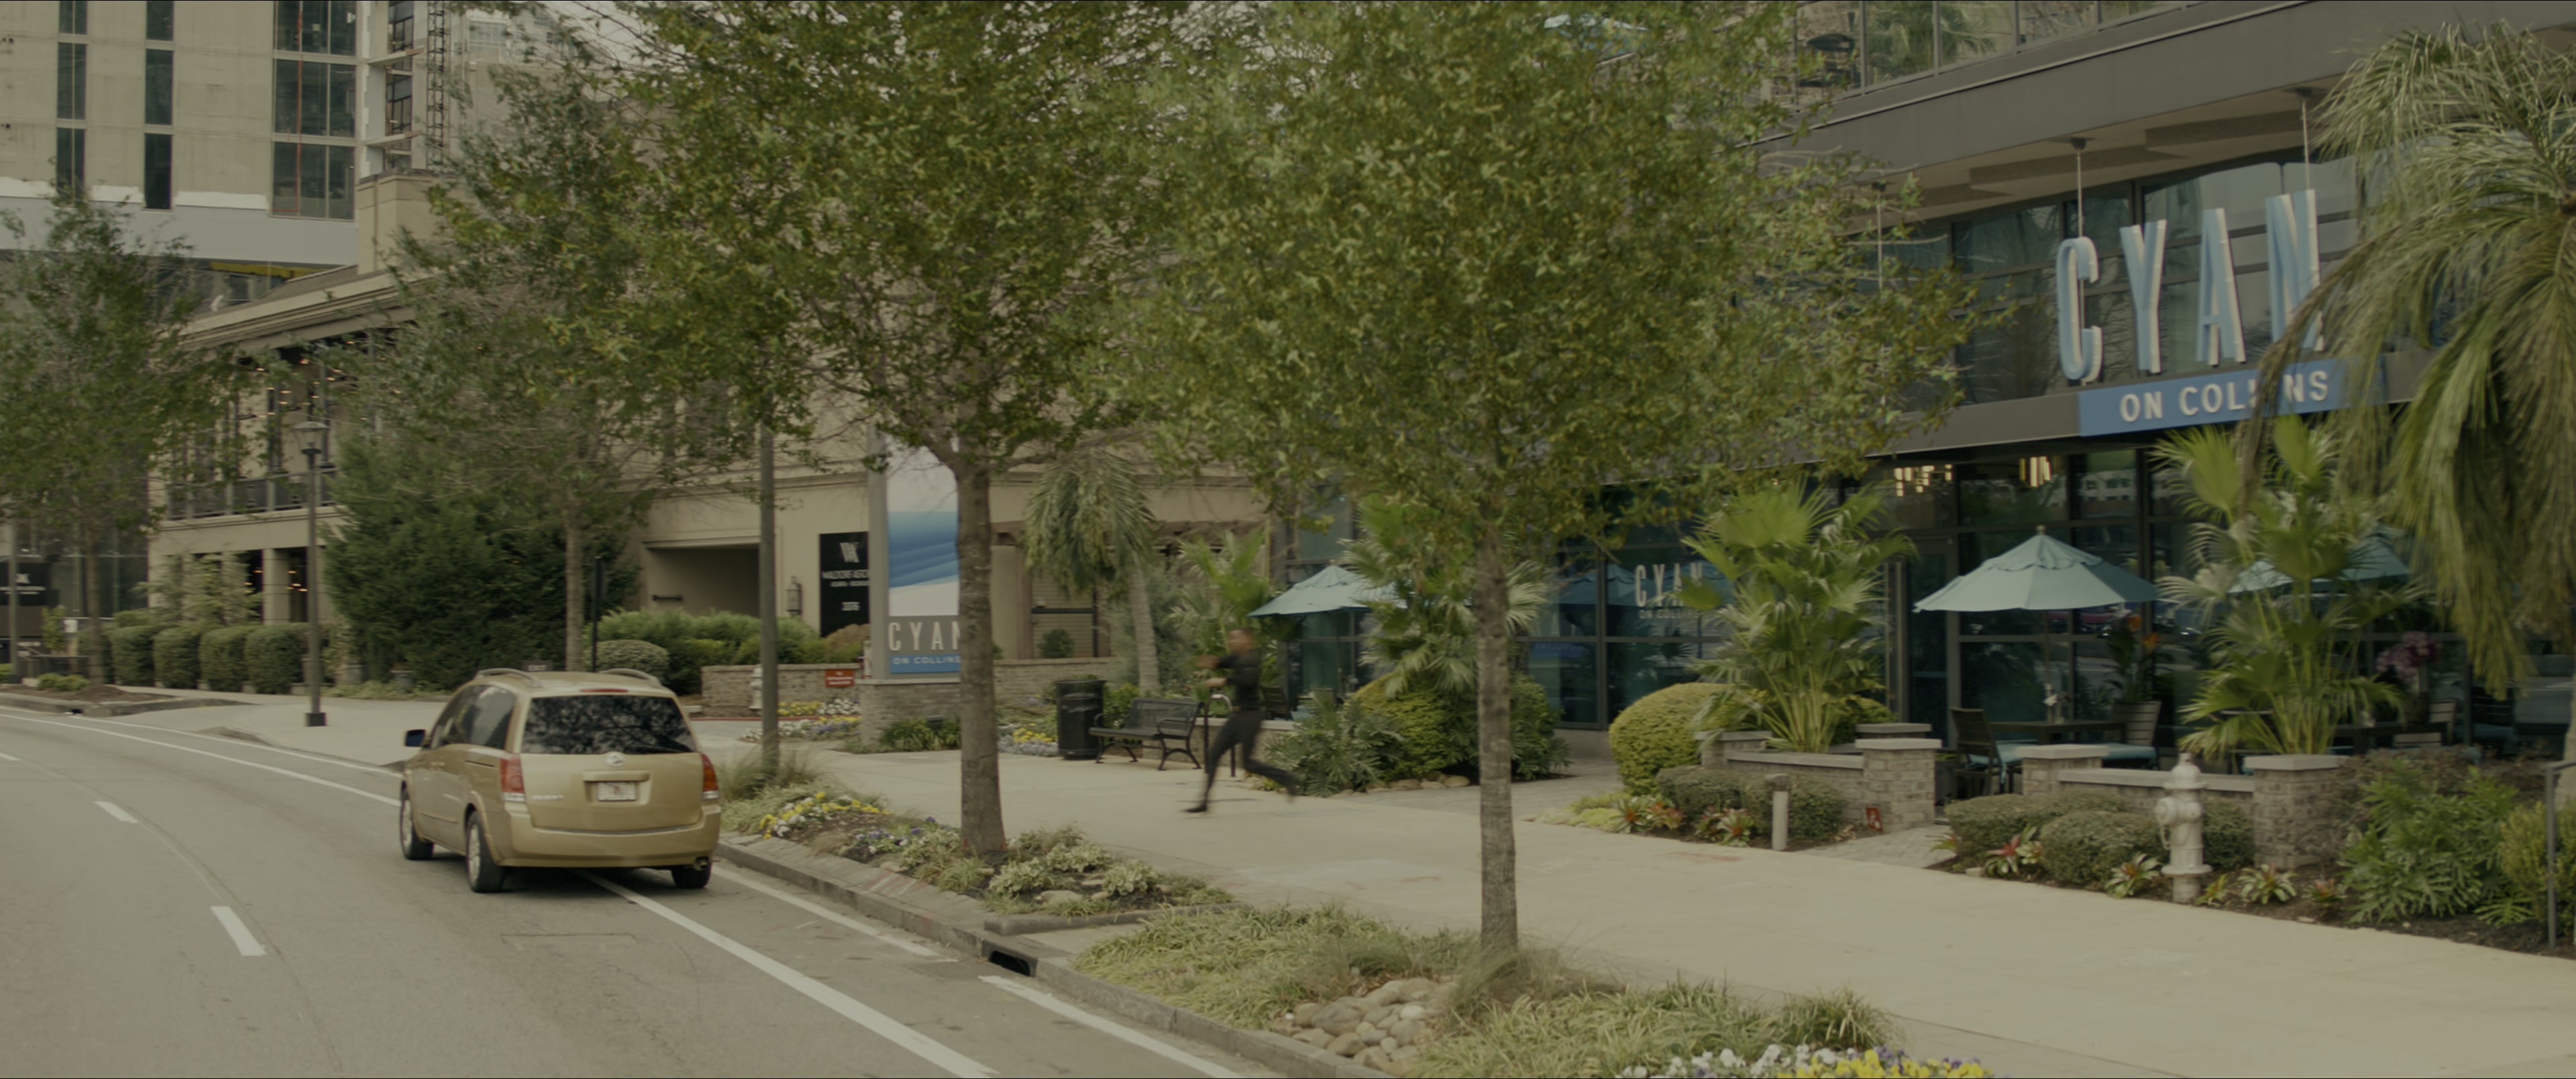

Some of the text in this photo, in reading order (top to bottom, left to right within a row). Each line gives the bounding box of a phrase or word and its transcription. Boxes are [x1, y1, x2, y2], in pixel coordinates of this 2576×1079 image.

[2055, 189, 2325, 384] CYAN
[2119, 370, 2329, 423] ON COLNS
[1657, 609, 1700, 619] COLL
[892, 656, 961, 665] ON COLLINS
